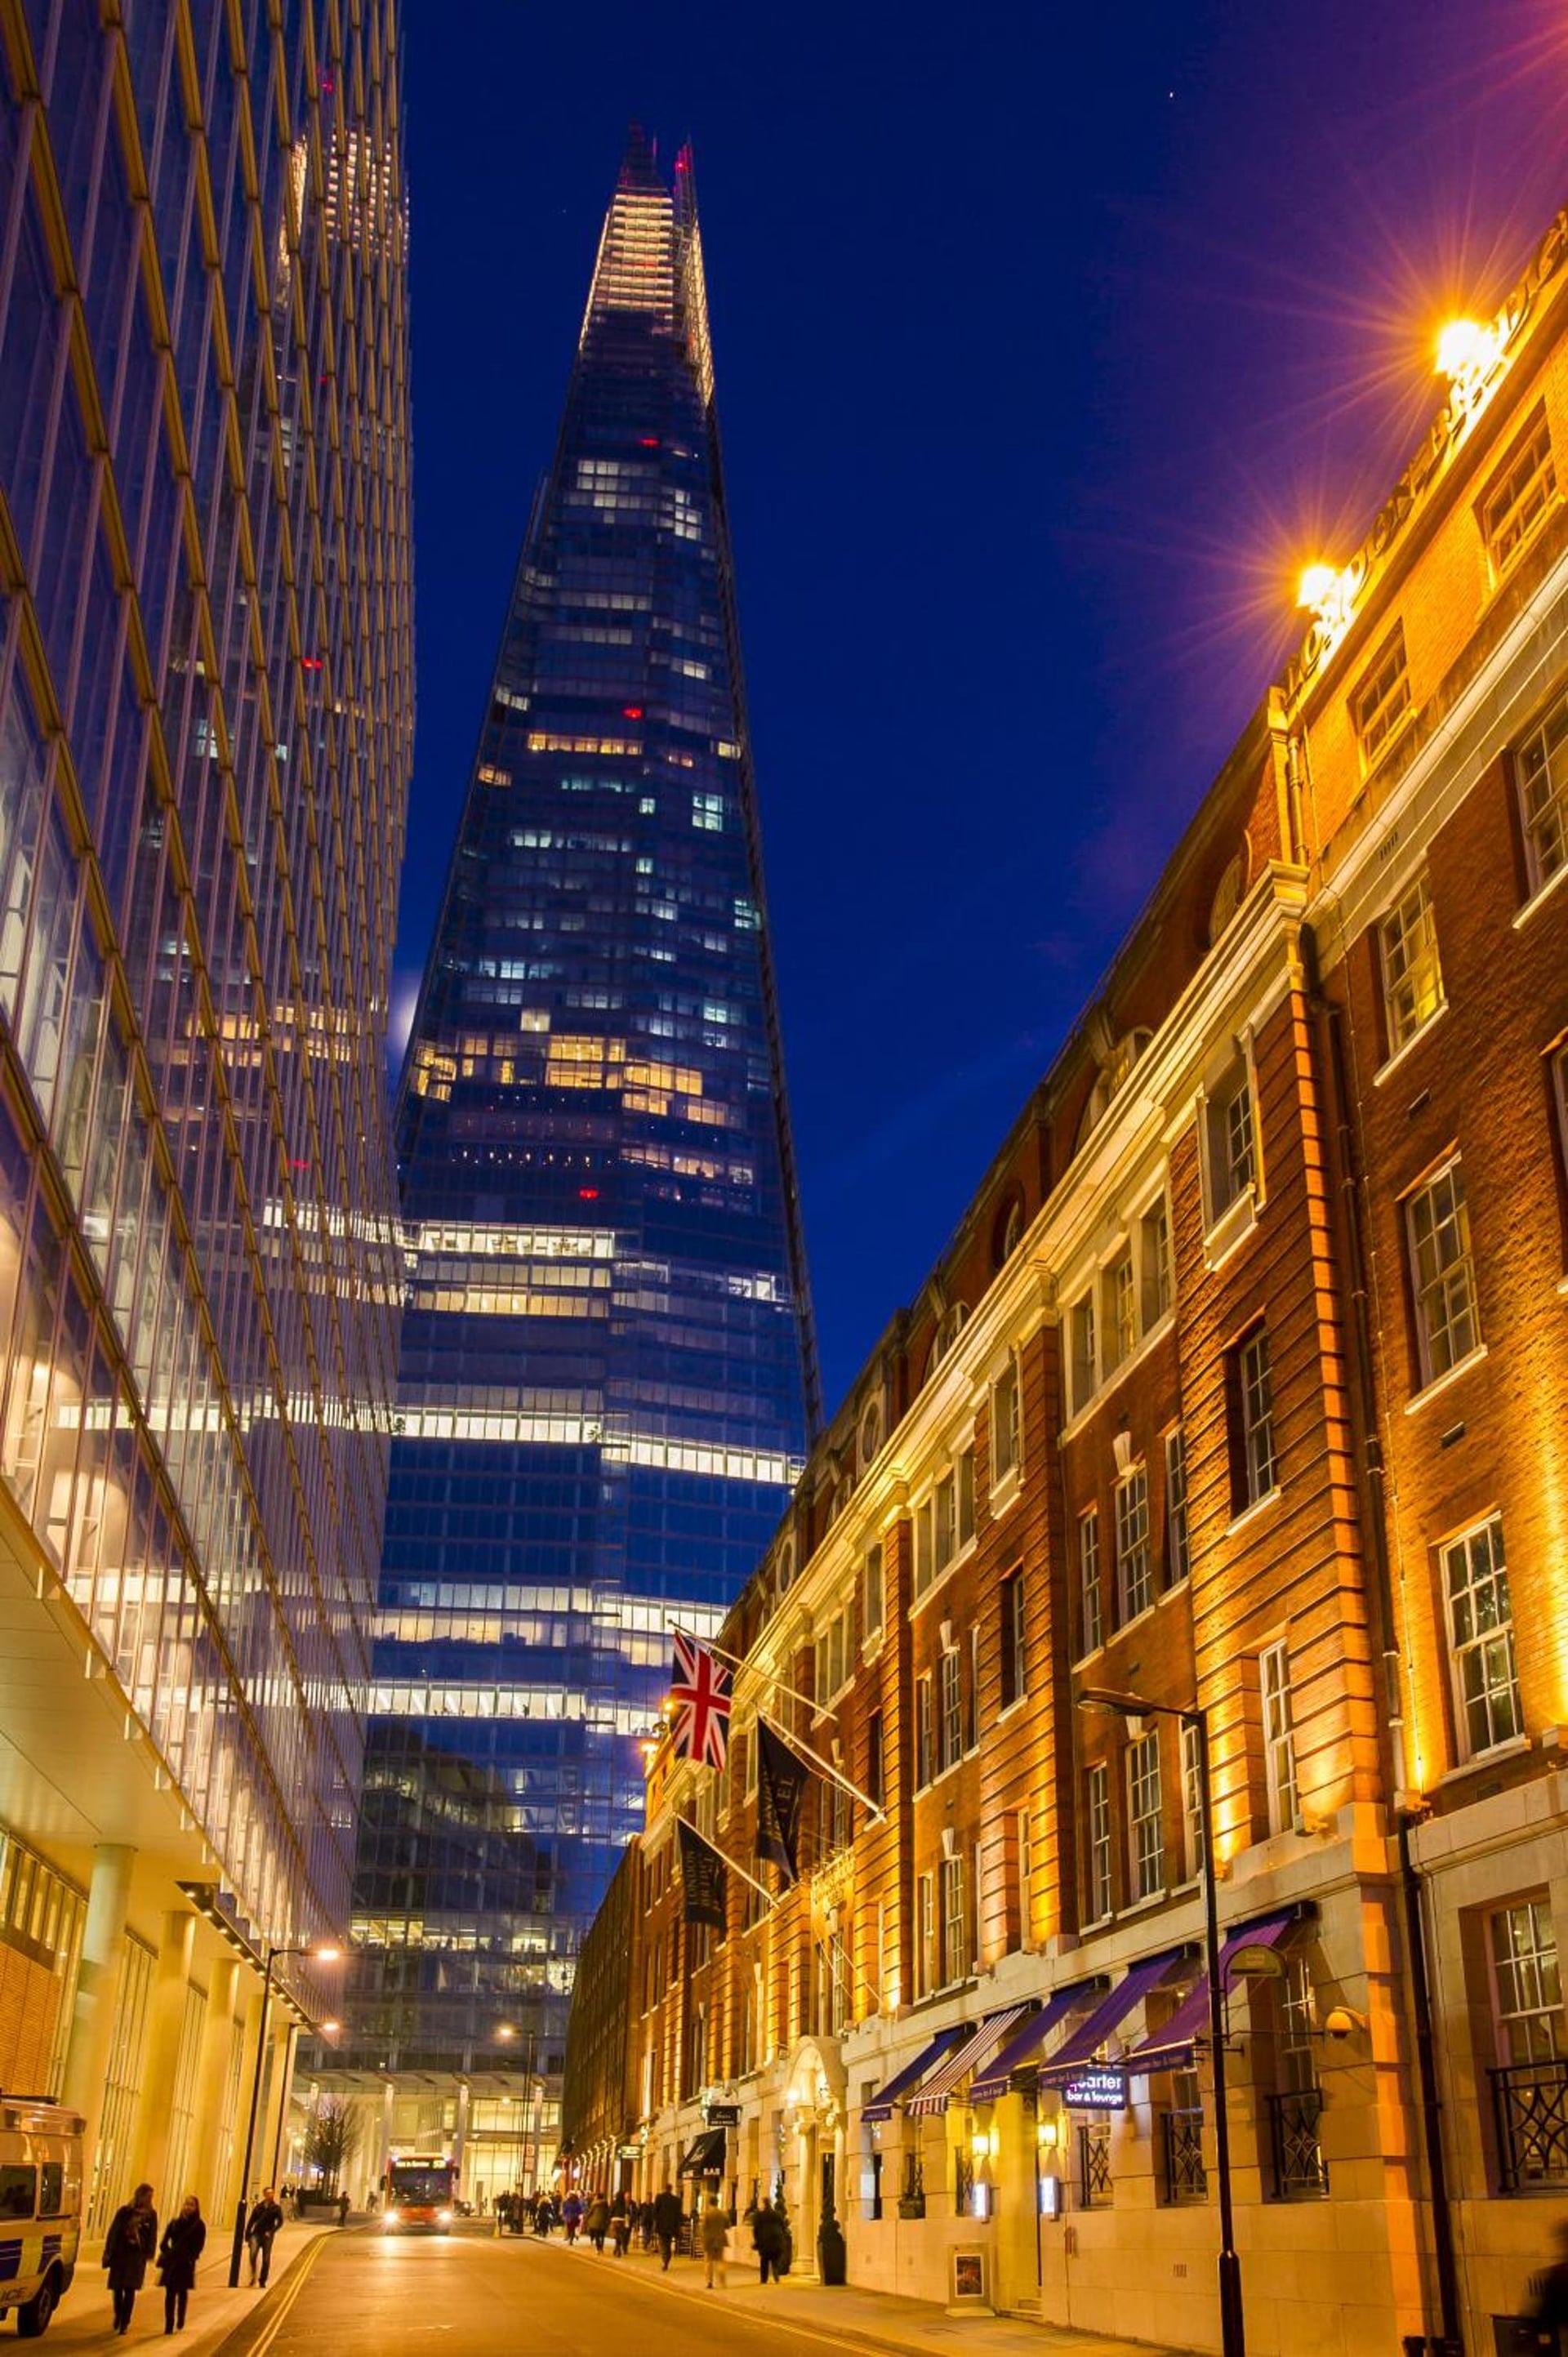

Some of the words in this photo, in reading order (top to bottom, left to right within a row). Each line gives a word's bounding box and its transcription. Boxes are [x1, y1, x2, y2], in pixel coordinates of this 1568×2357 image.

[1066, 2089, 1083, 2101] bar
[1084, 2092, 1091, 2101] &
[1091, 2090, 1123, 2105] lounge
